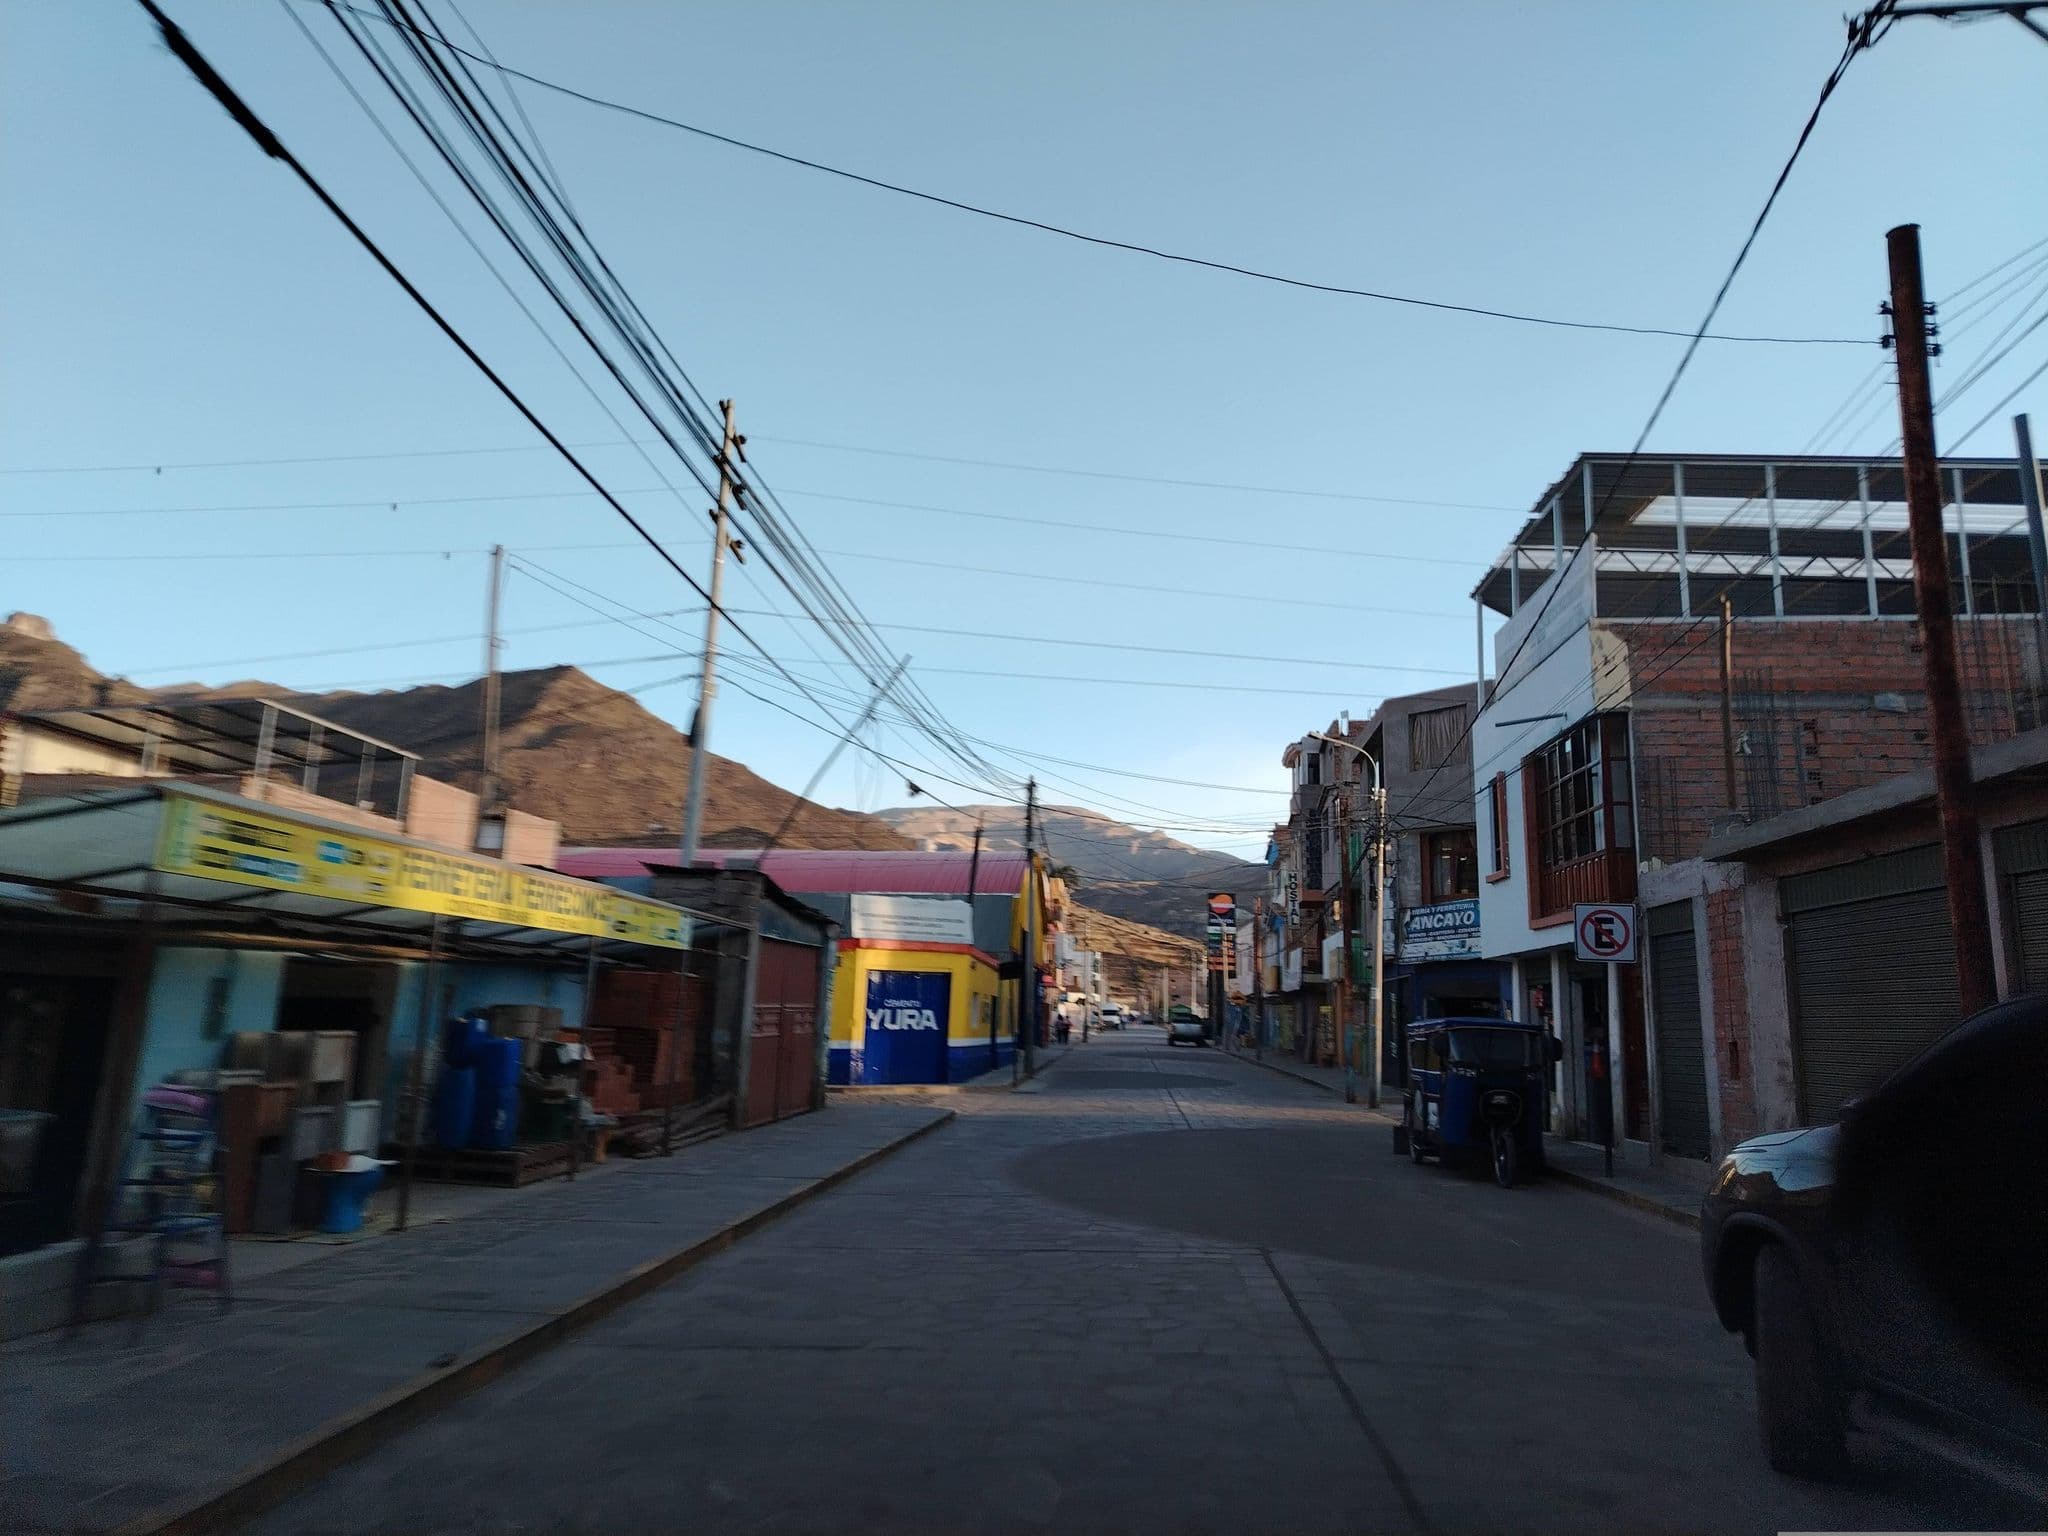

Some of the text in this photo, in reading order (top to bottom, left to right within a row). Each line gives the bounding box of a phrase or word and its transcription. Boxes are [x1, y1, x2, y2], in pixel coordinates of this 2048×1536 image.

[1289, 873, 1299, 925] HOSTAL
[1595, 917, 1615, 948] E
[867, 1008, 939, 1030] YURA
